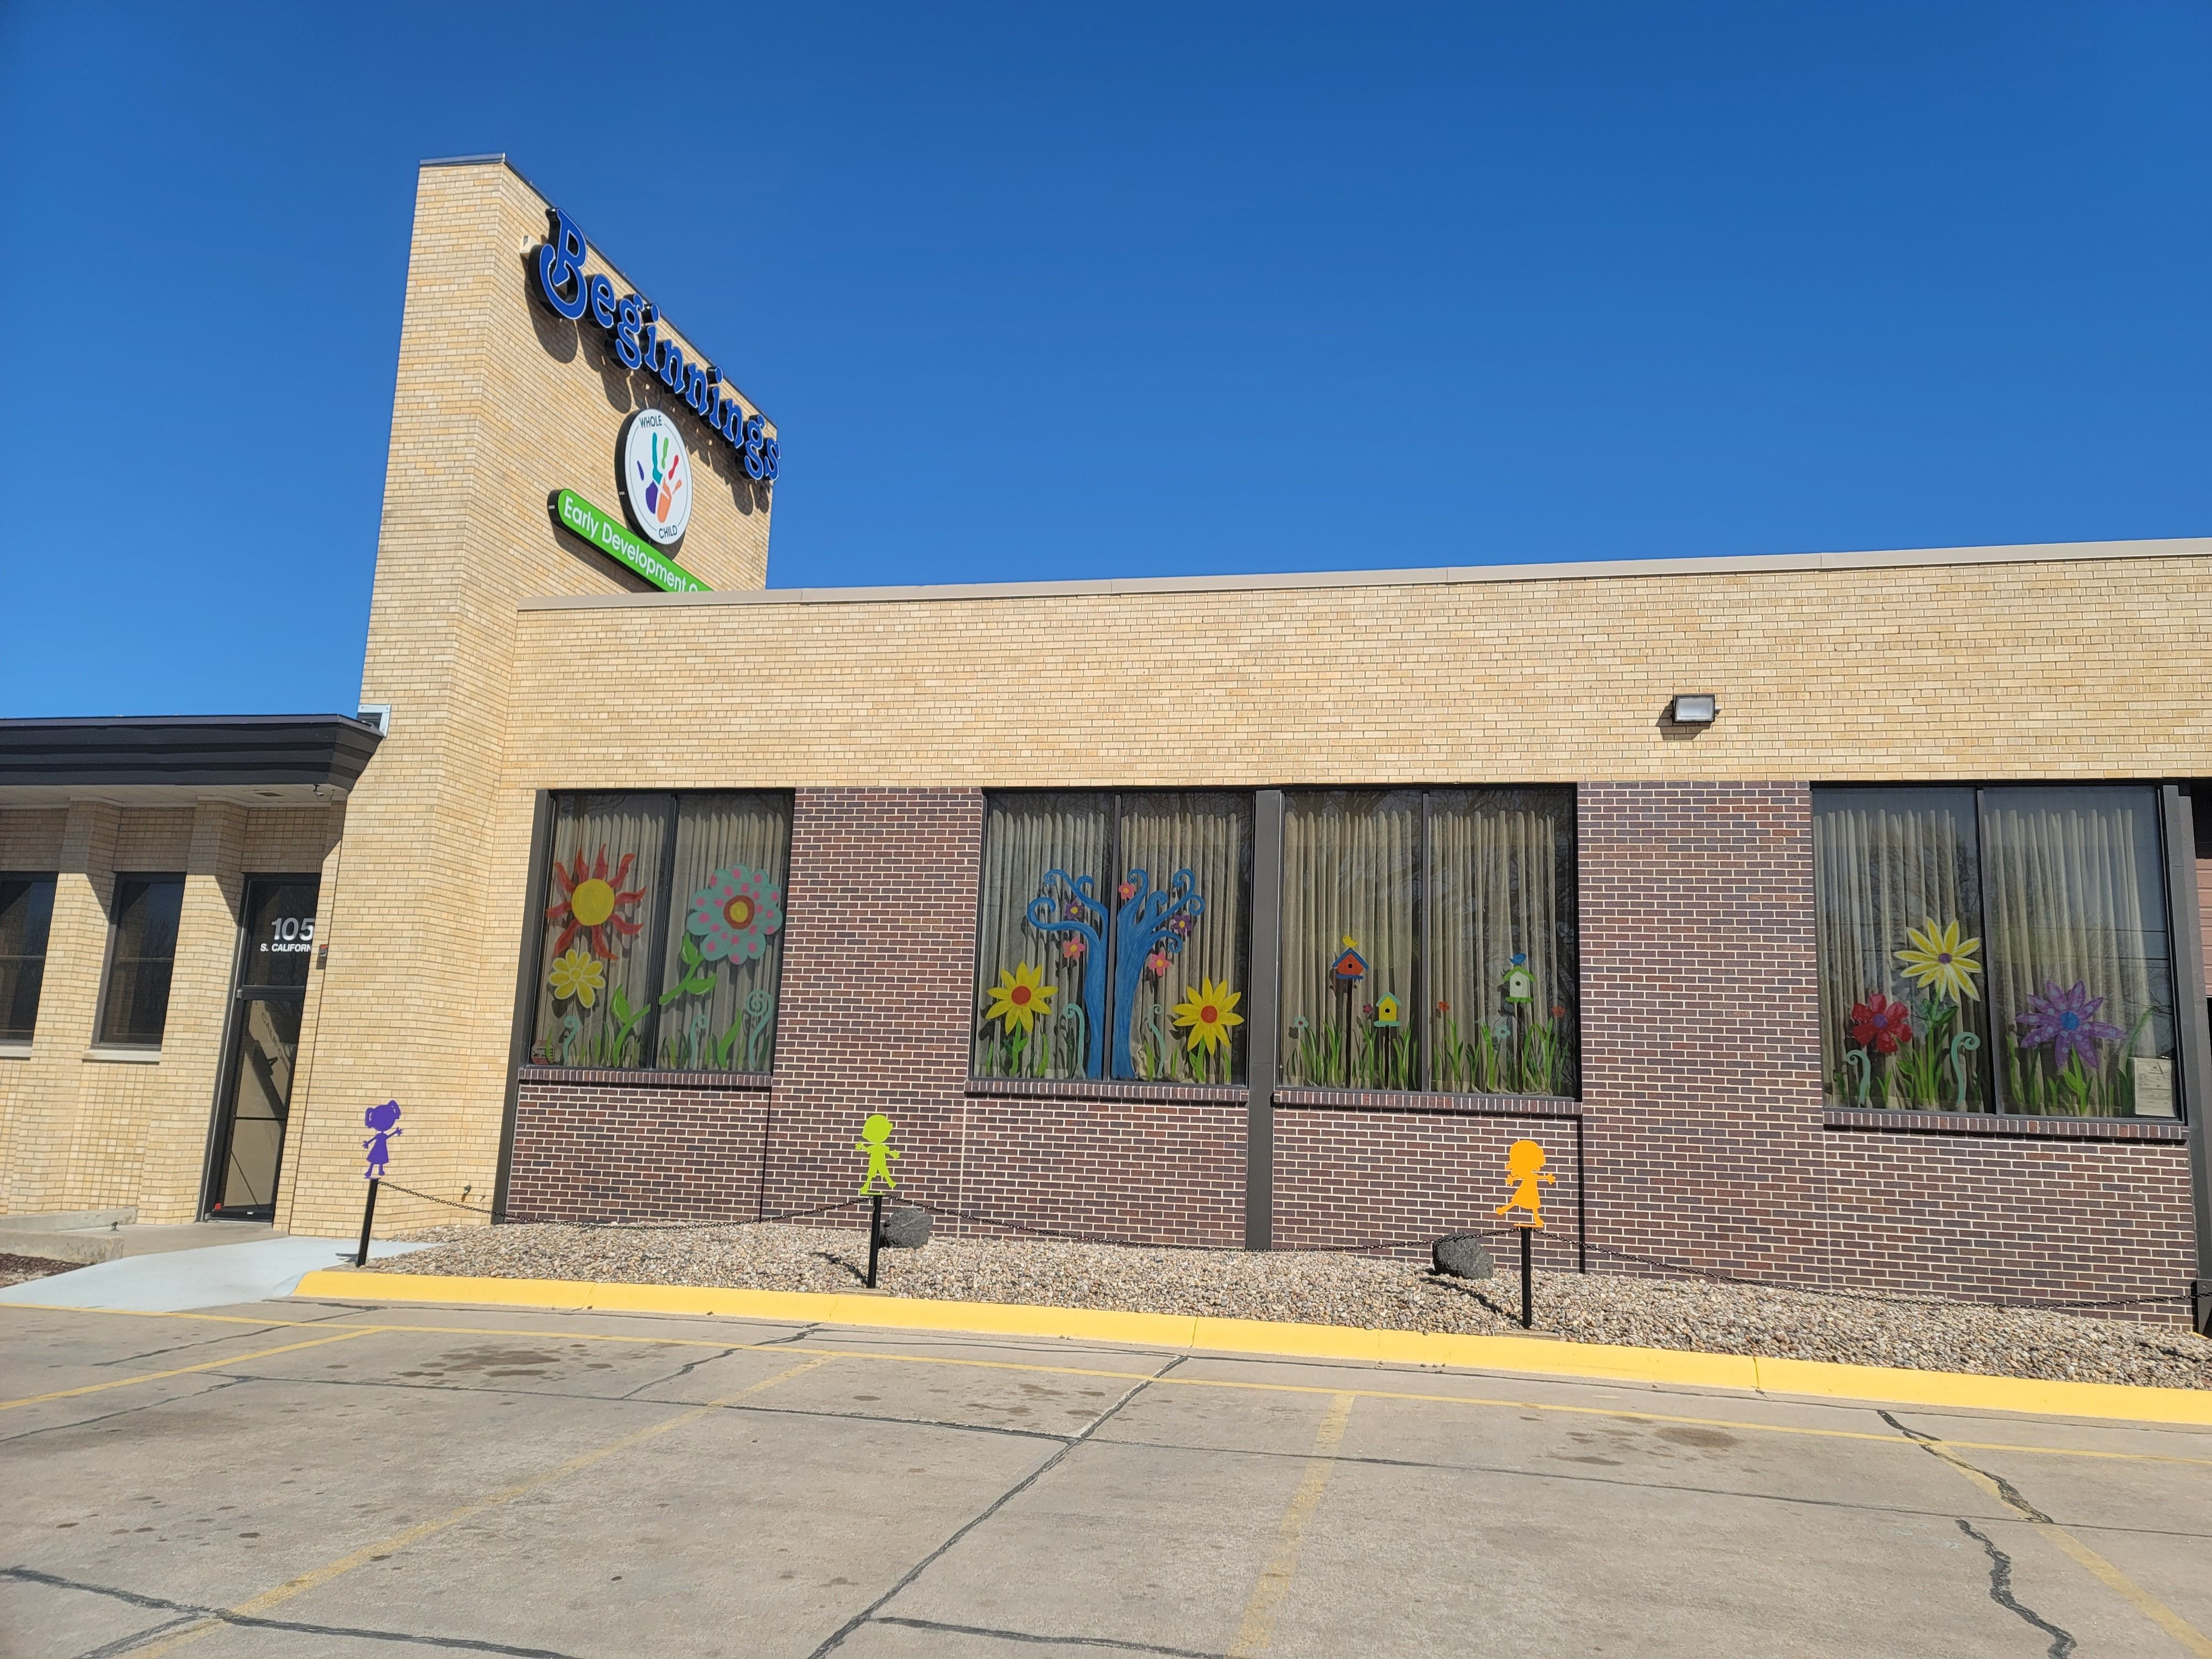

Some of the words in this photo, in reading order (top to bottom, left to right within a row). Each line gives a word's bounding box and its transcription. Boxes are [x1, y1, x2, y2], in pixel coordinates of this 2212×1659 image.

[539, 208, 781, 481] Beginnings
[639, 415, 662, 429] WHOLE
[659, 525, 677, 539] CHILD
[564, 495, 599, 539] Early
[602, 521, 686, 593] Development
[271, 917, 315, 941] 105
[260, 943, 269, 952] S.
